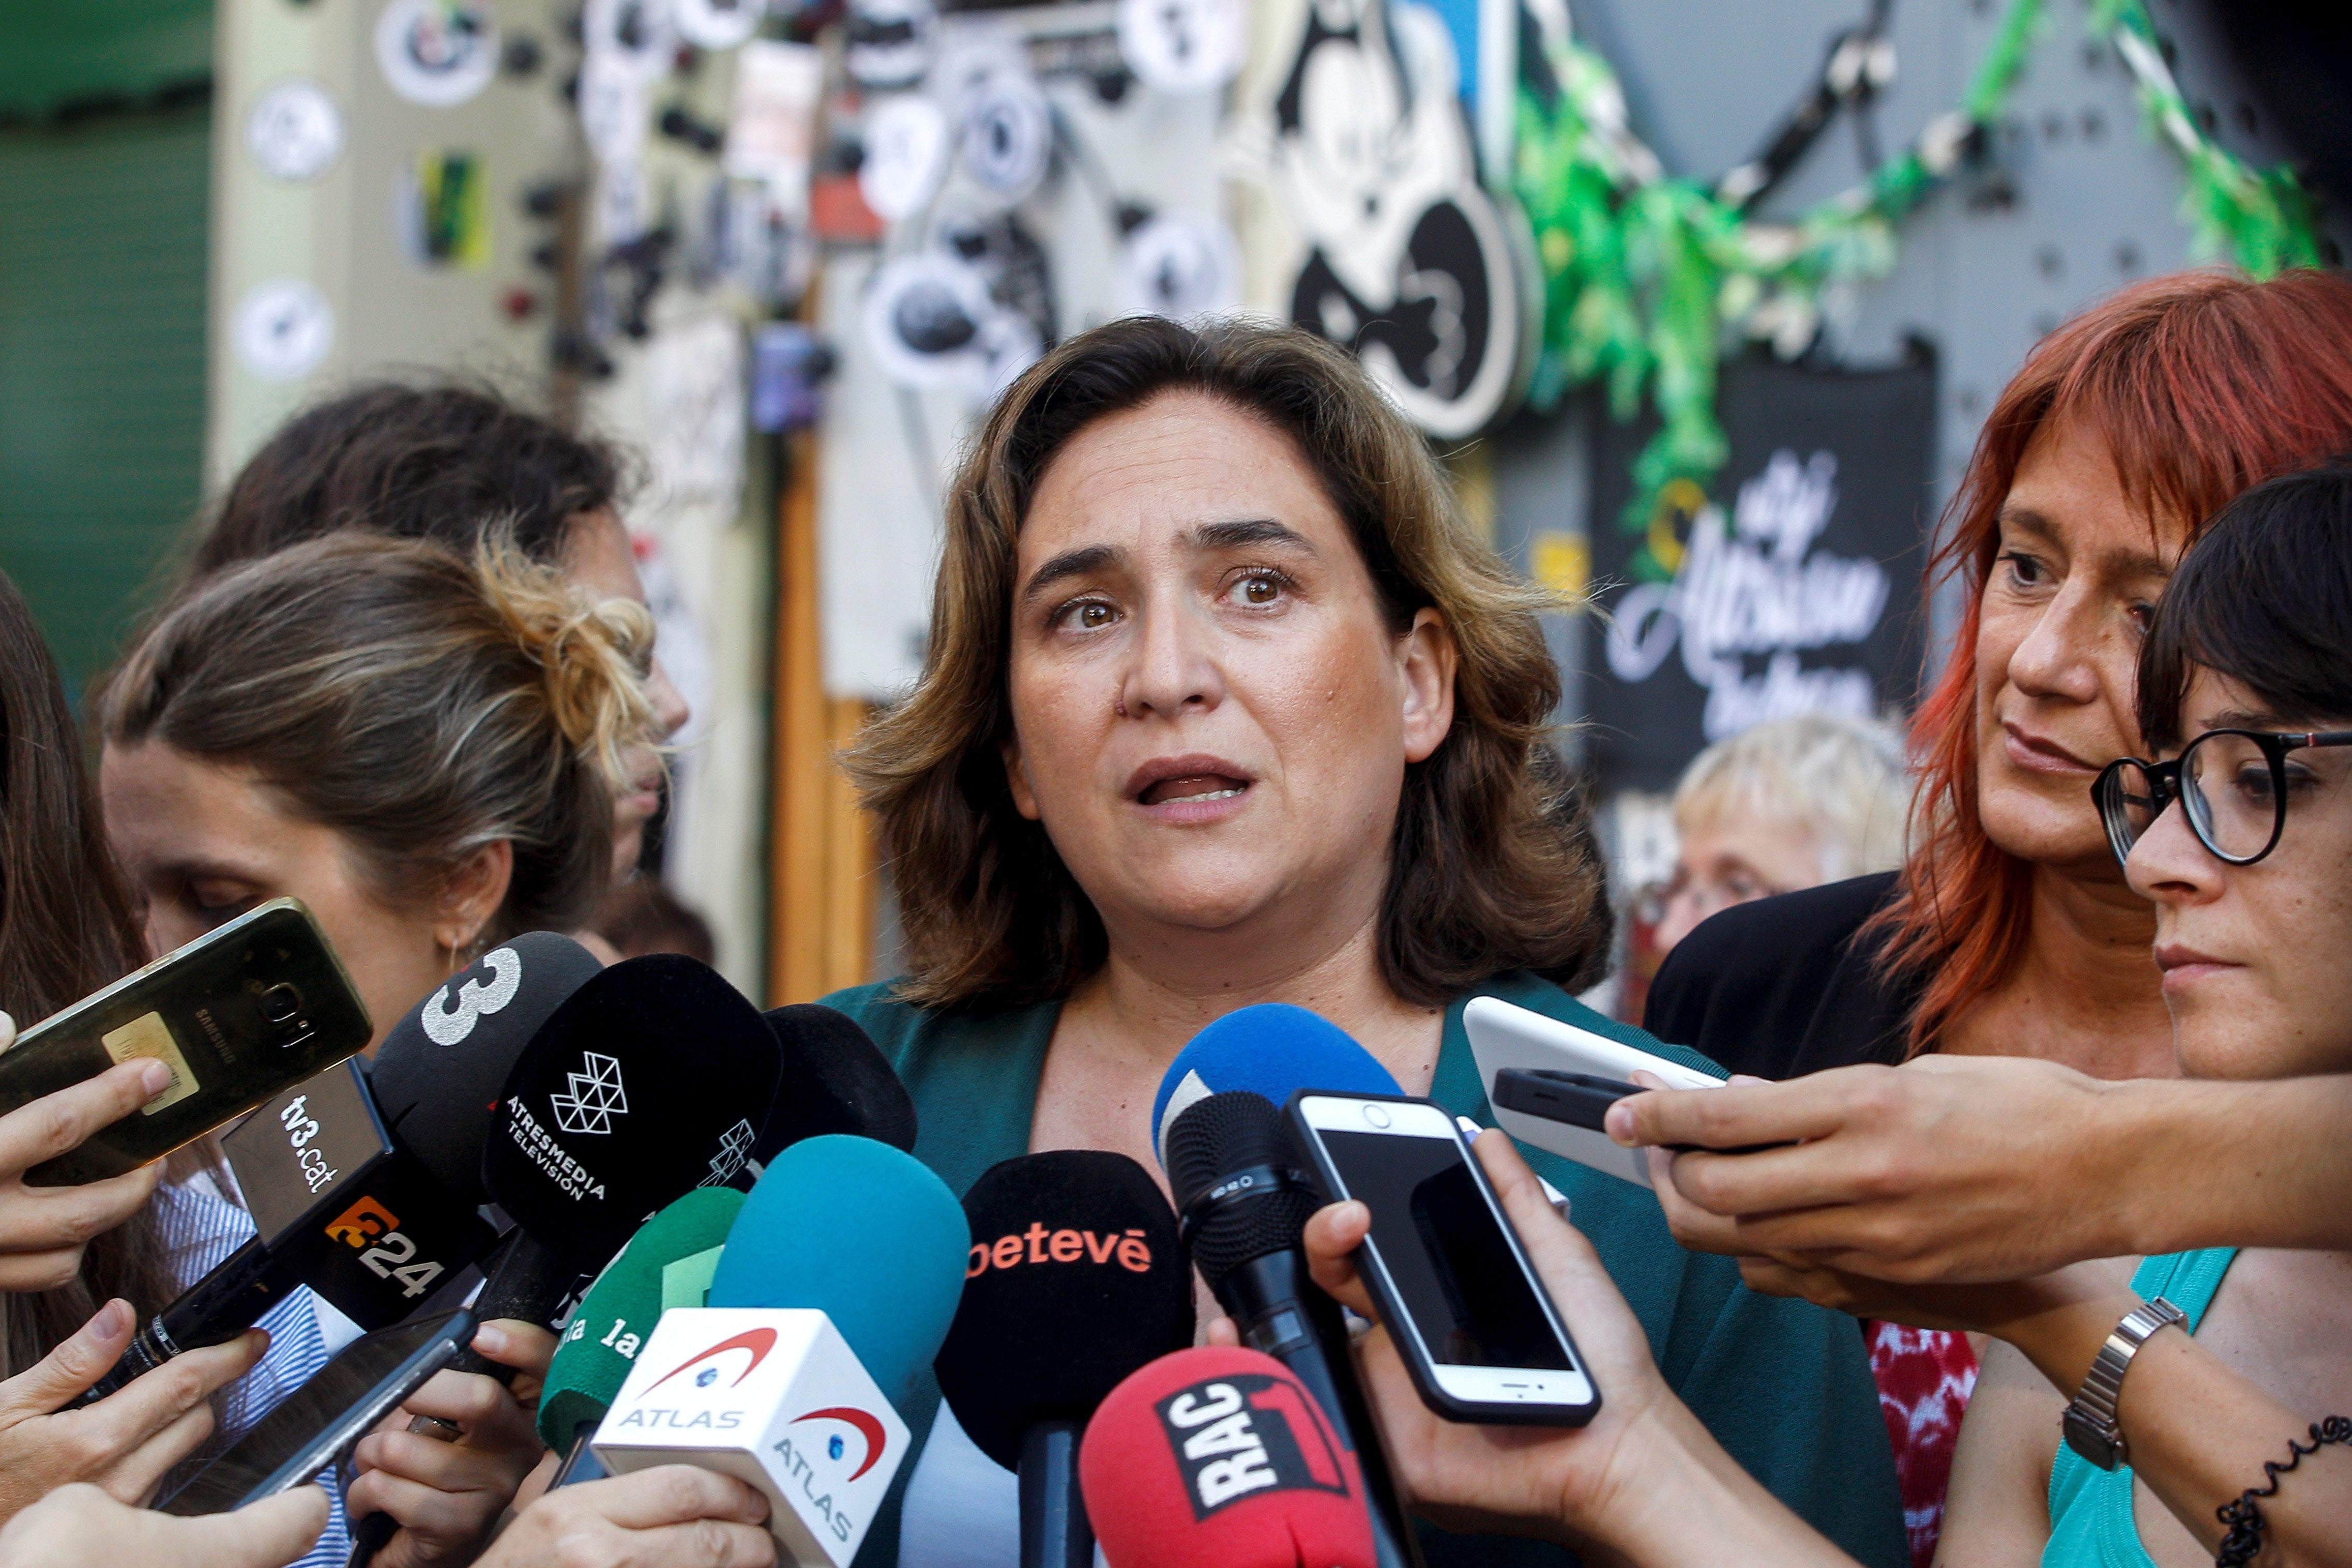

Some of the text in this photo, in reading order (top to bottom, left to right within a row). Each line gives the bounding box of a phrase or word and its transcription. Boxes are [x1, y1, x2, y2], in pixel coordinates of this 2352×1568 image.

[194, 1008, 236, 1064] SAMSUNG
[420, 947, 522, 1047] 3
[280, 1094, 339, 1194] tv3.cat
[507, 1095, 605, 1200] ATRESMEDIA
[508, 1120, 584, 1201] TELEVISIÓN
[617, 1409, 745, 1428] ATLAS
[773, 1438, 853, 1543] ATLAS
